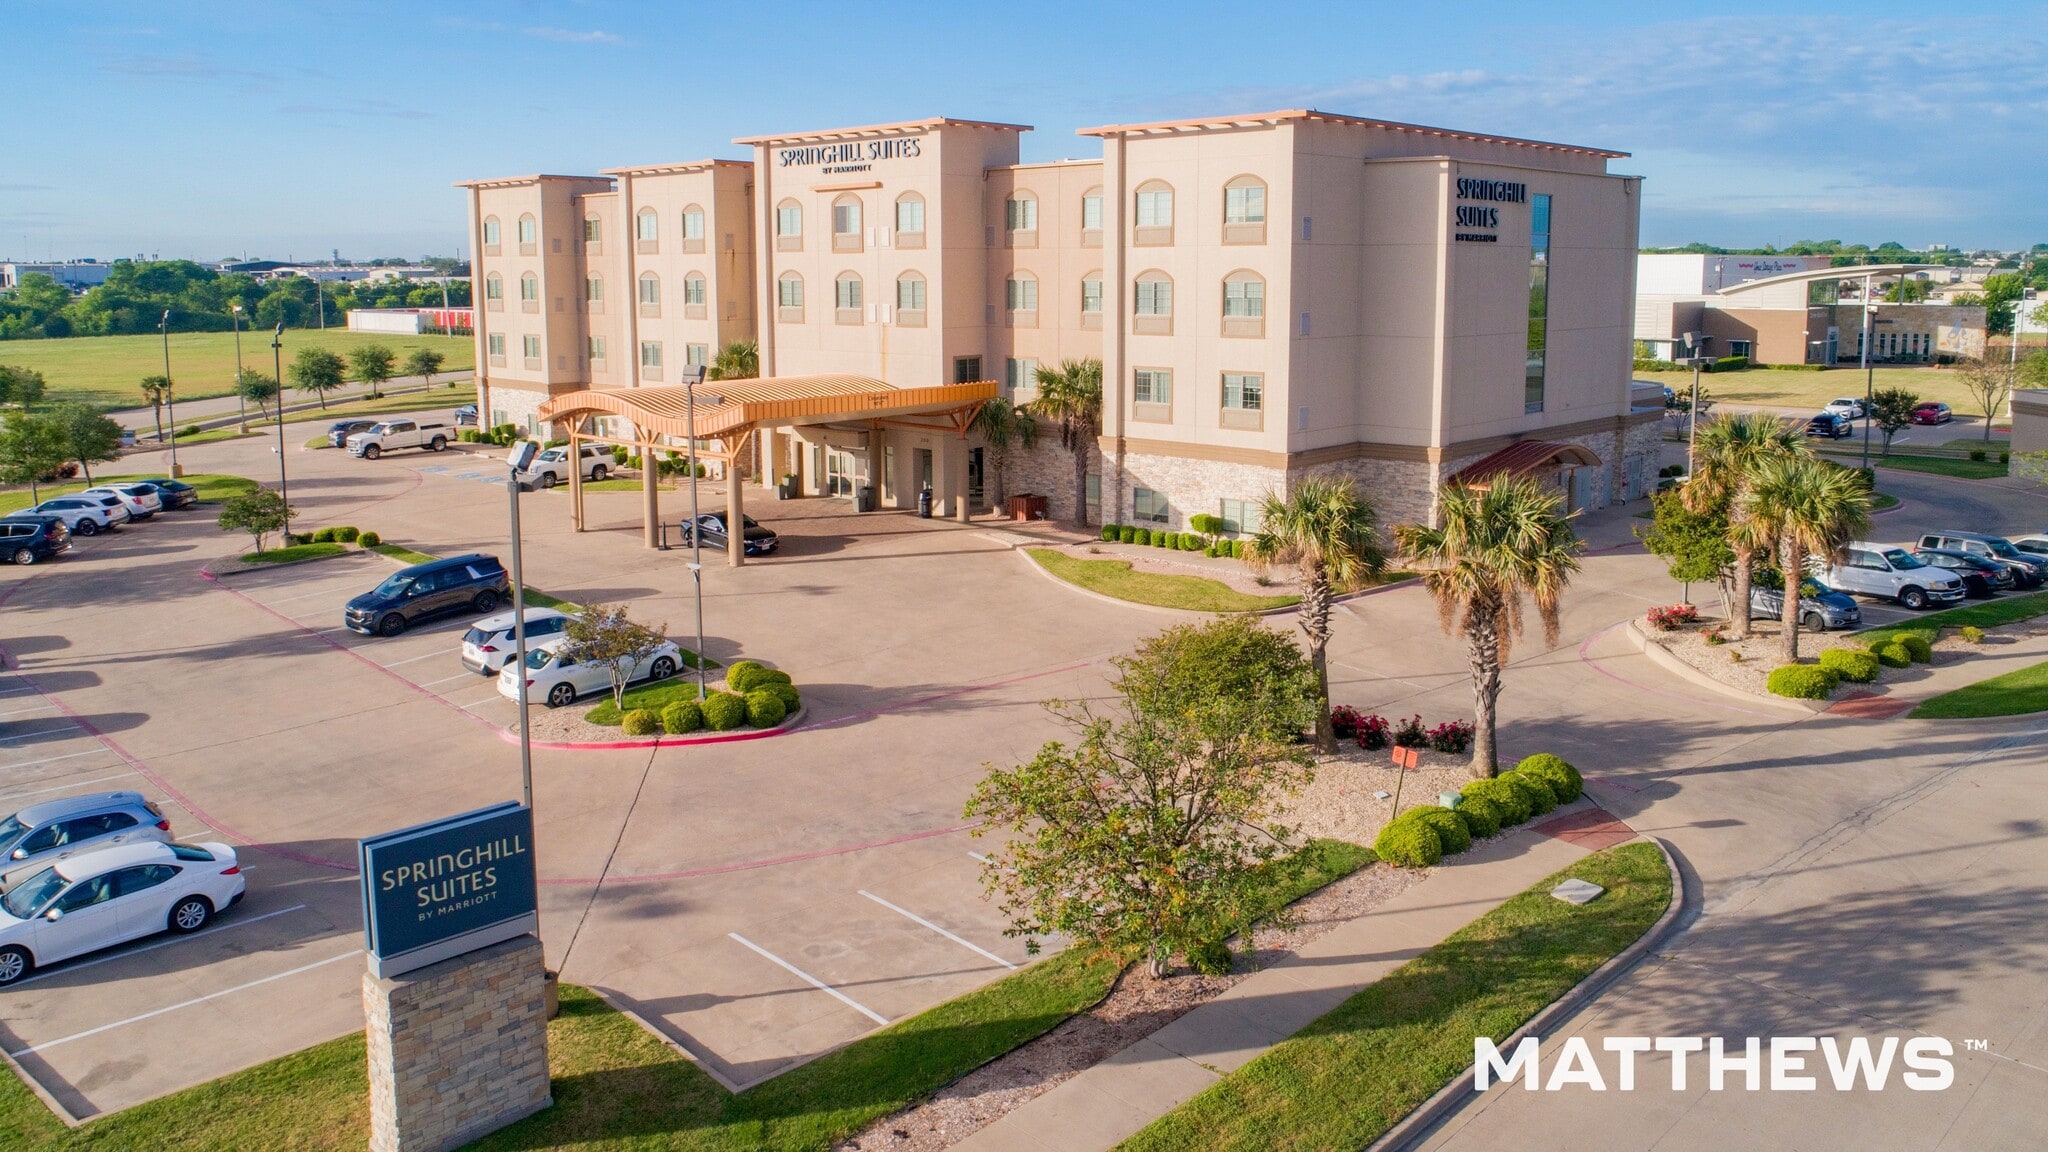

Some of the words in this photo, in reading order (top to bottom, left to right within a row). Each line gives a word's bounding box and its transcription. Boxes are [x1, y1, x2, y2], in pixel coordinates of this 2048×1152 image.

[779, 142, 865, 168] SPRINGHILL
[868, 138, 921, 160] SUITES
[1456, 177, 1527, 203] SPRINGHILL
[1456, 205, 1499, 228] SUITES
[381, 835, 526, 891] SPRINGHILL
[417, 867, 497, 907] SUITES
[418, 911, 433, 922] BY
[438, 891, 498, 915] MARRIOTT
